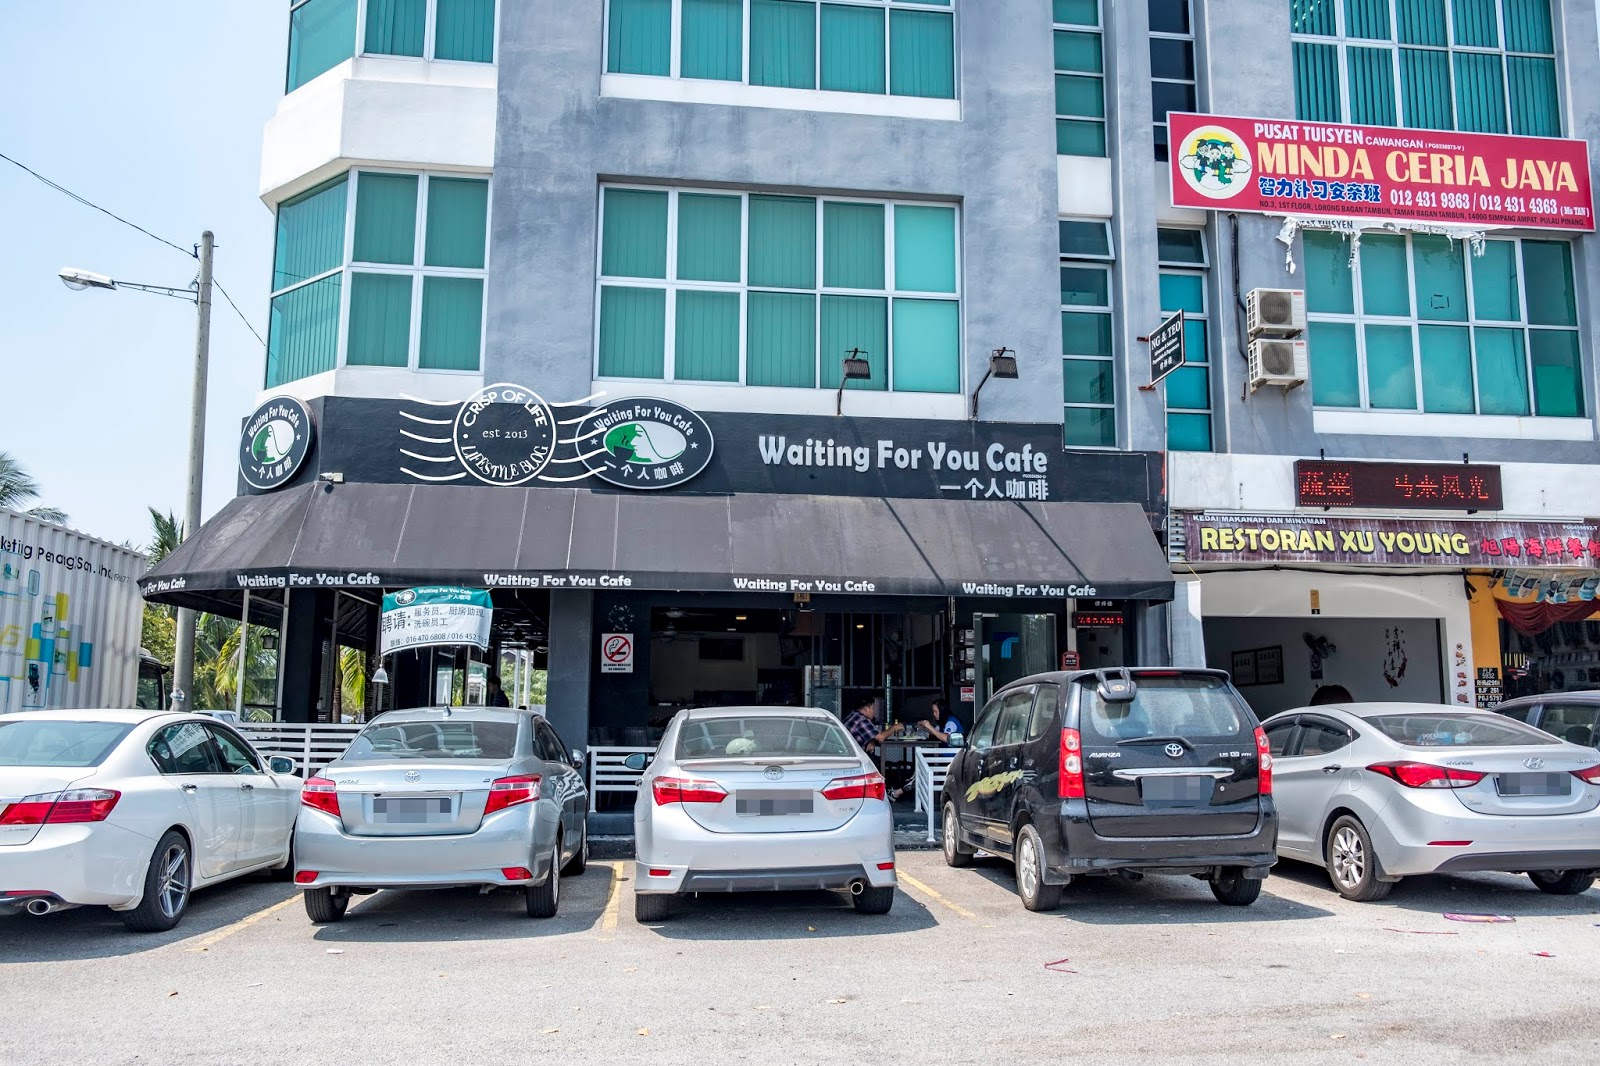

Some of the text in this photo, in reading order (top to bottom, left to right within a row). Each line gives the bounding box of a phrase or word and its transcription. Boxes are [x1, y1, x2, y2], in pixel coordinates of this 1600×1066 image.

[1254, 123, 1299, 140] PUSAT
[1302, 126, 1364, 145] TUISYEN
[1365, 136, 1424, 149] CAWANGAN
[1257, 142, 1578, 192] MINDA CERIA JAYA
[1390, 189, 1412, 206] 012
[1415, 190, 1437, 207] 431
[1440, 191, 1470, 210] 9363
[1479, 194, 1501, 211] 012
[1505, 196, 1525, 212] 431
[1529, 197, 1558, 214] 4363
[1314, 204, 1340, 212] LORONG
[1341, 205, 1364, 213] BAGAN
[1468, 213, 1487, 221] 14000
[1488, 214, 1516, 222] SIMPANG
[1540, 217, 1560, 225] PULAU
[1151, 335, 1161, 350] NG
[1167, 321, 1180, 337] TEO
[248, 405, 300, 438] Waiting For You Cafe
[593, 405, 694, 436] Waiting For You Cafe
[758, 436, 1048, 474] Waiting For You Cafe
[251, 455, 293, 480] 一个人咖啡
[604, 460, 685, 480] 一个人咖啡
[940, 478, 1049, 500] 一个人咖啡
[1192, 514, 1219, 522] KEDAI
[1222, 515, 1264, 523] MAKANAN
[1285, 517, 1326, 525] MINUMAN
[1201, 527, 1470, 555] RESTORAN XU YOUNG
[148, 582, 157, 593] For
[158, 581, 170, 591] You
[171, 577, 186, 589] Cafe
[237, 572, 380, 587] Waiting For You Cafe
[484, 574, 632, 588] Waiting For You Cafe
[733, 578, 875, 592] Waiting For You Cafe
[962, 582, 1096, 597] Waiting For You Cafe
